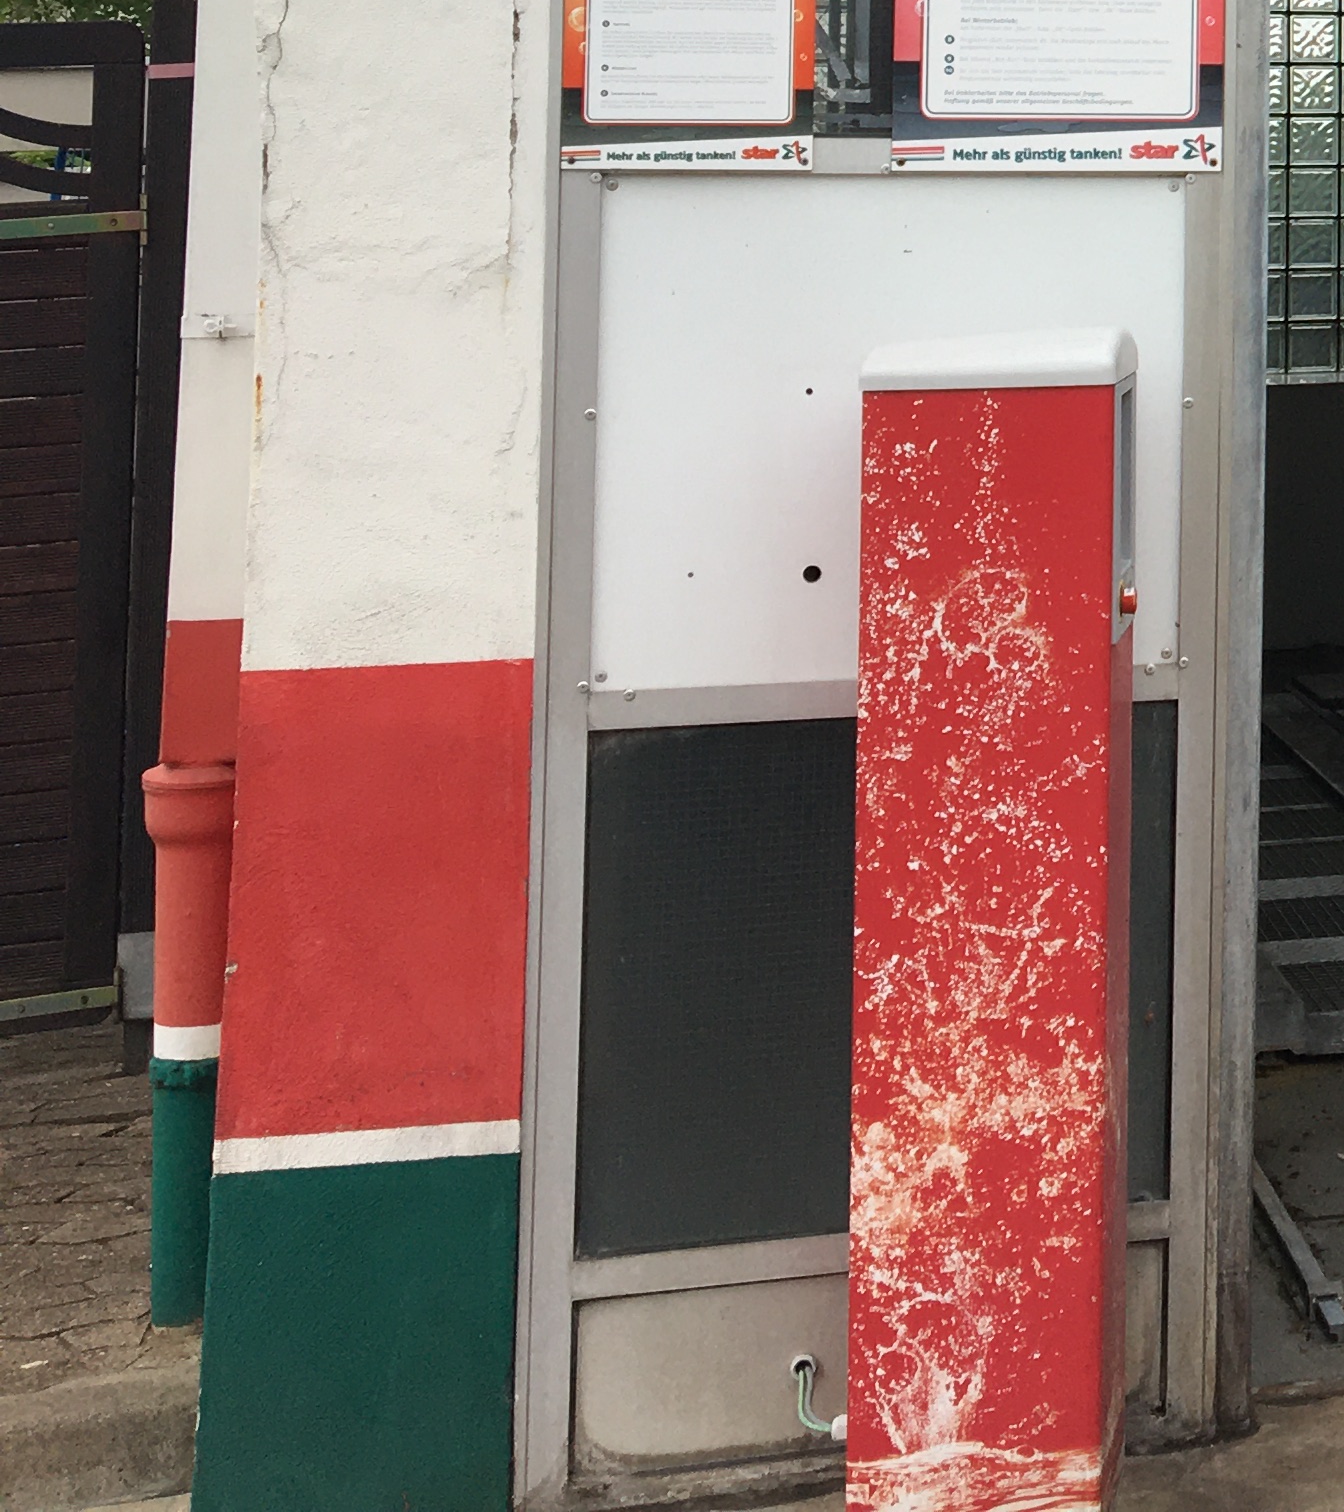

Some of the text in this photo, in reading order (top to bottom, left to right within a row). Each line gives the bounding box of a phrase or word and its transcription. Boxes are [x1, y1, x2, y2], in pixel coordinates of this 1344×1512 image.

[606, 150, 736, 162] Mehr als günstig tanken!
[741, 146, 780, 160] star
[953, 147, 1122, 163] Mehr als günstig tanken!
[1129, 141, 1179, 159] star
